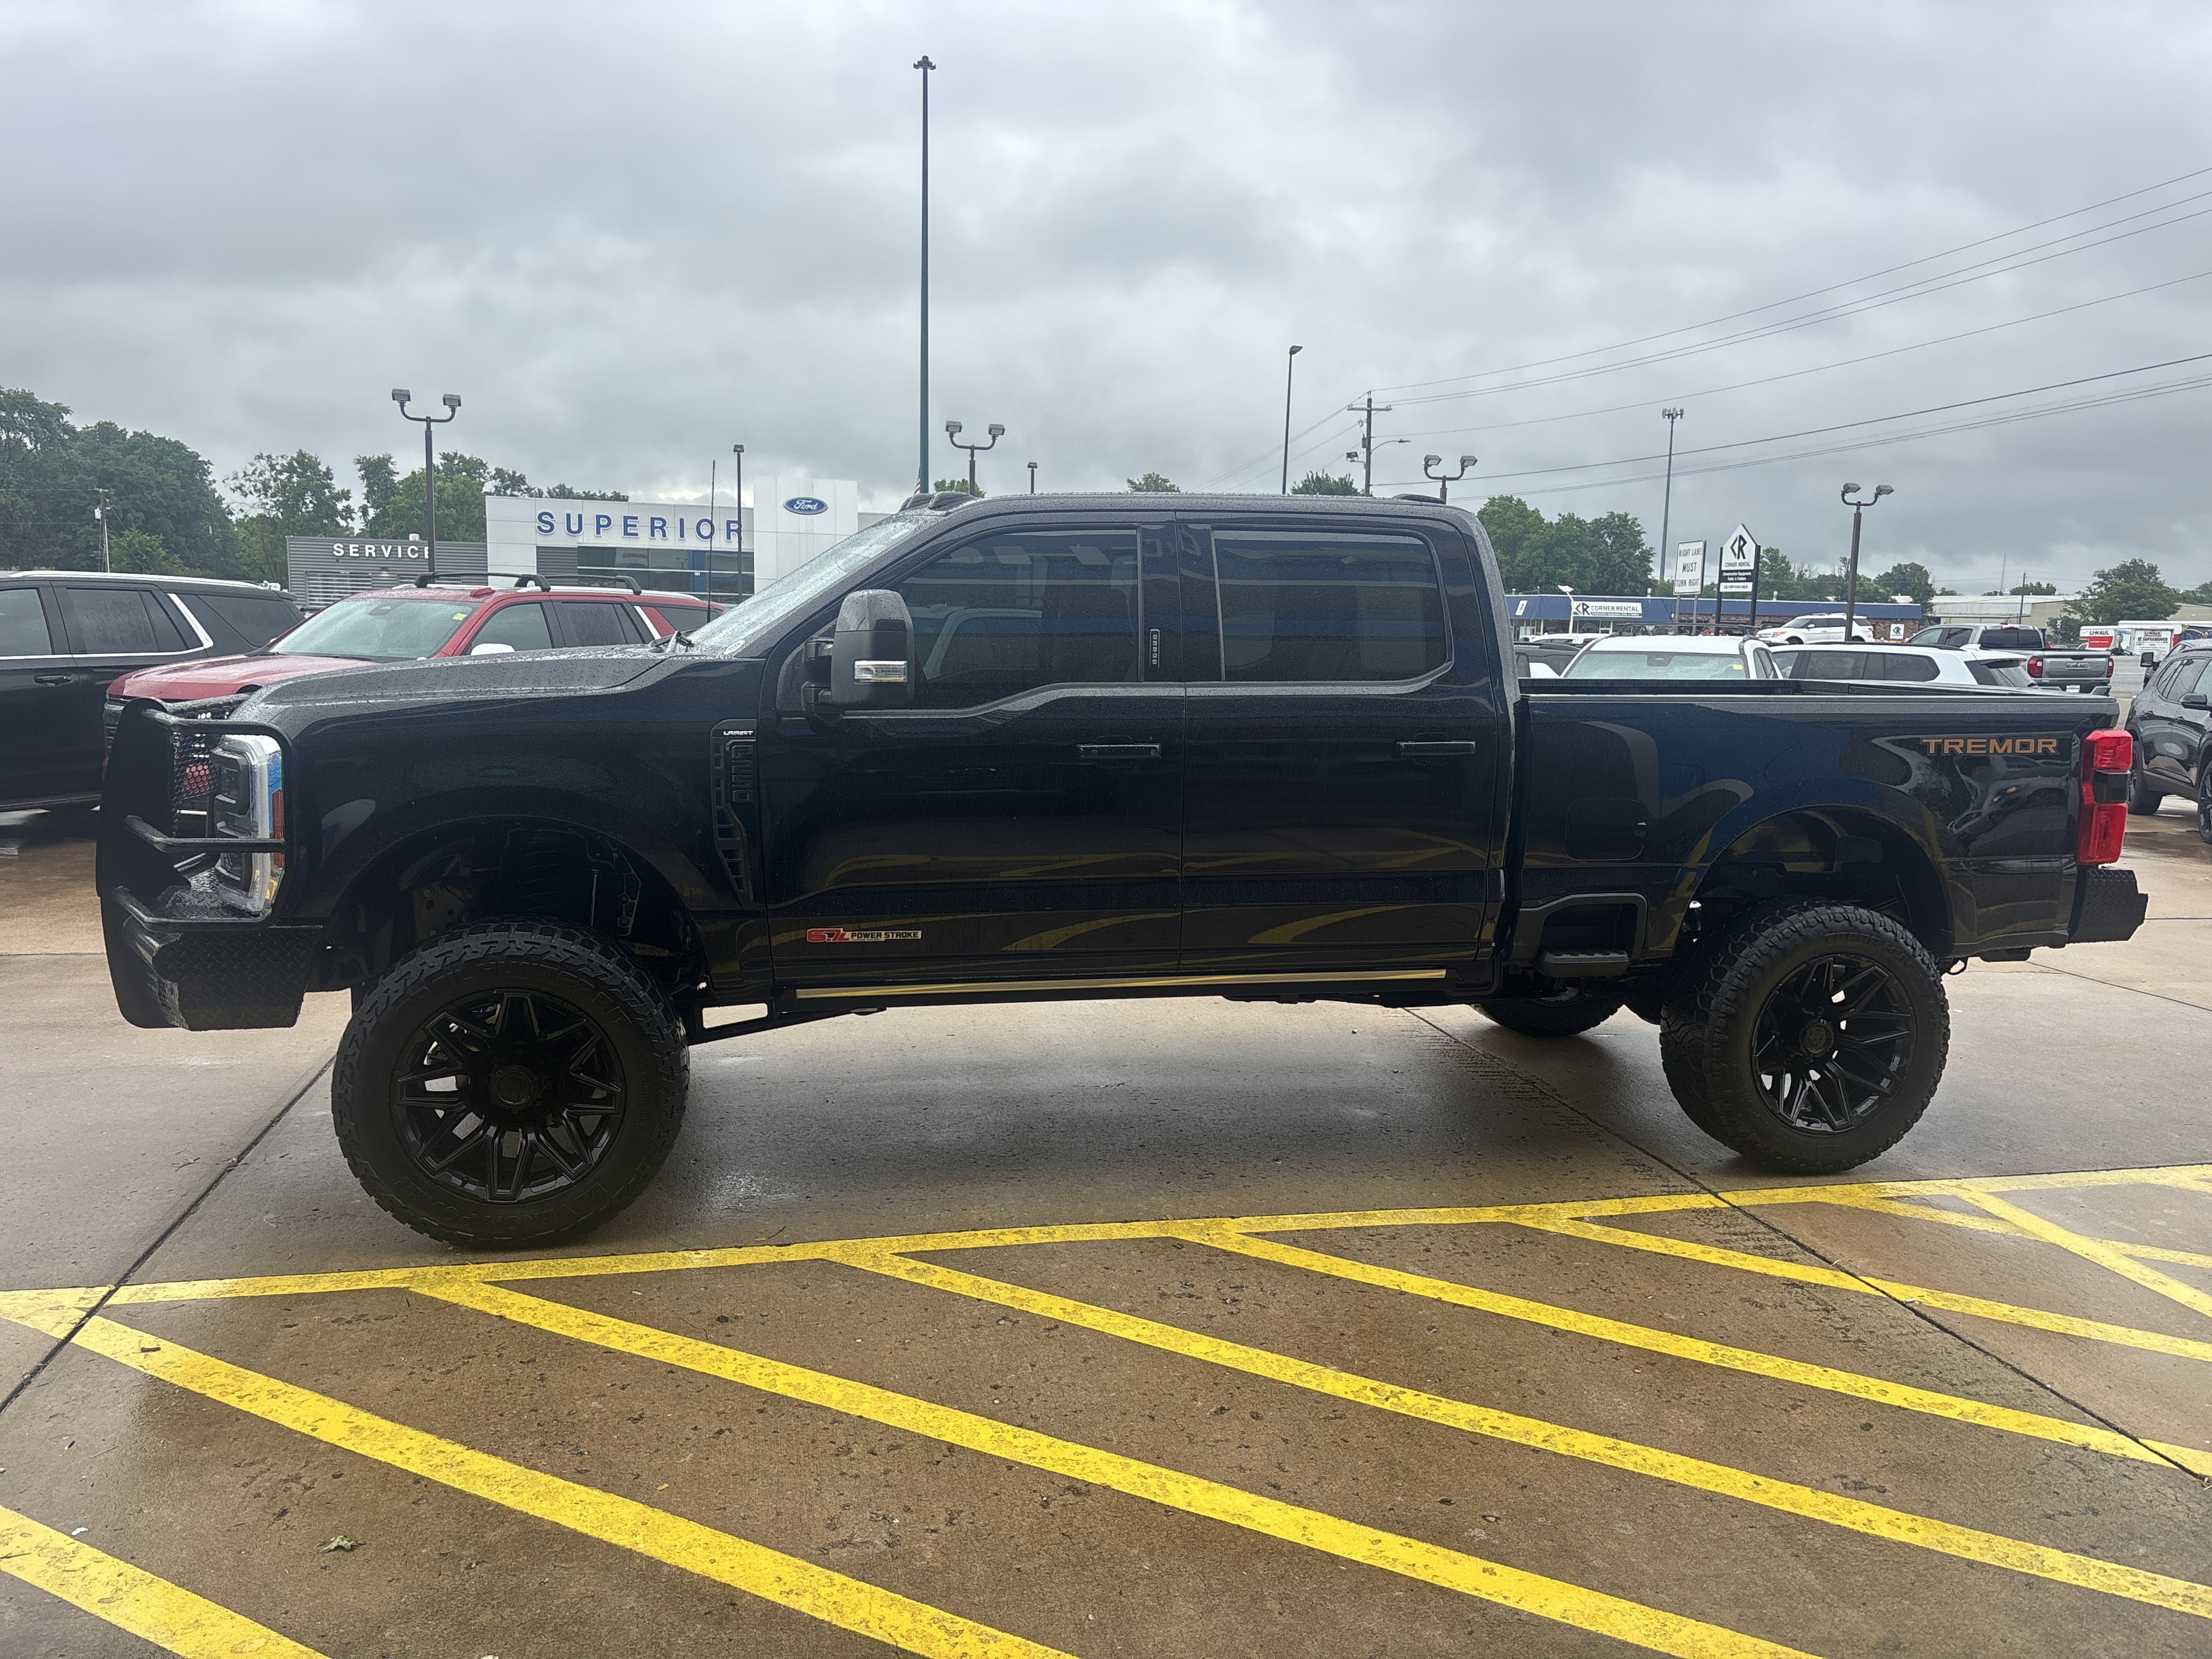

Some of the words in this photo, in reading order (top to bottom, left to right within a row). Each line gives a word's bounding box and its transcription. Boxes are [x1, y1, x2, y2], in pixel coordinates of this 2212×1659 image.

[793, 499, 819, 510] Ford
[537, 511, 743, 541] SUPERIOR
[1679, 549, 1691, 557] RIGHT
[1692, 548, 1702, 556] LANE
[1682, 562, 1697, 573] MUST
[1922, 738, 2057, 754] TREMOR
[808, 929, 850, 942] 6.7L
